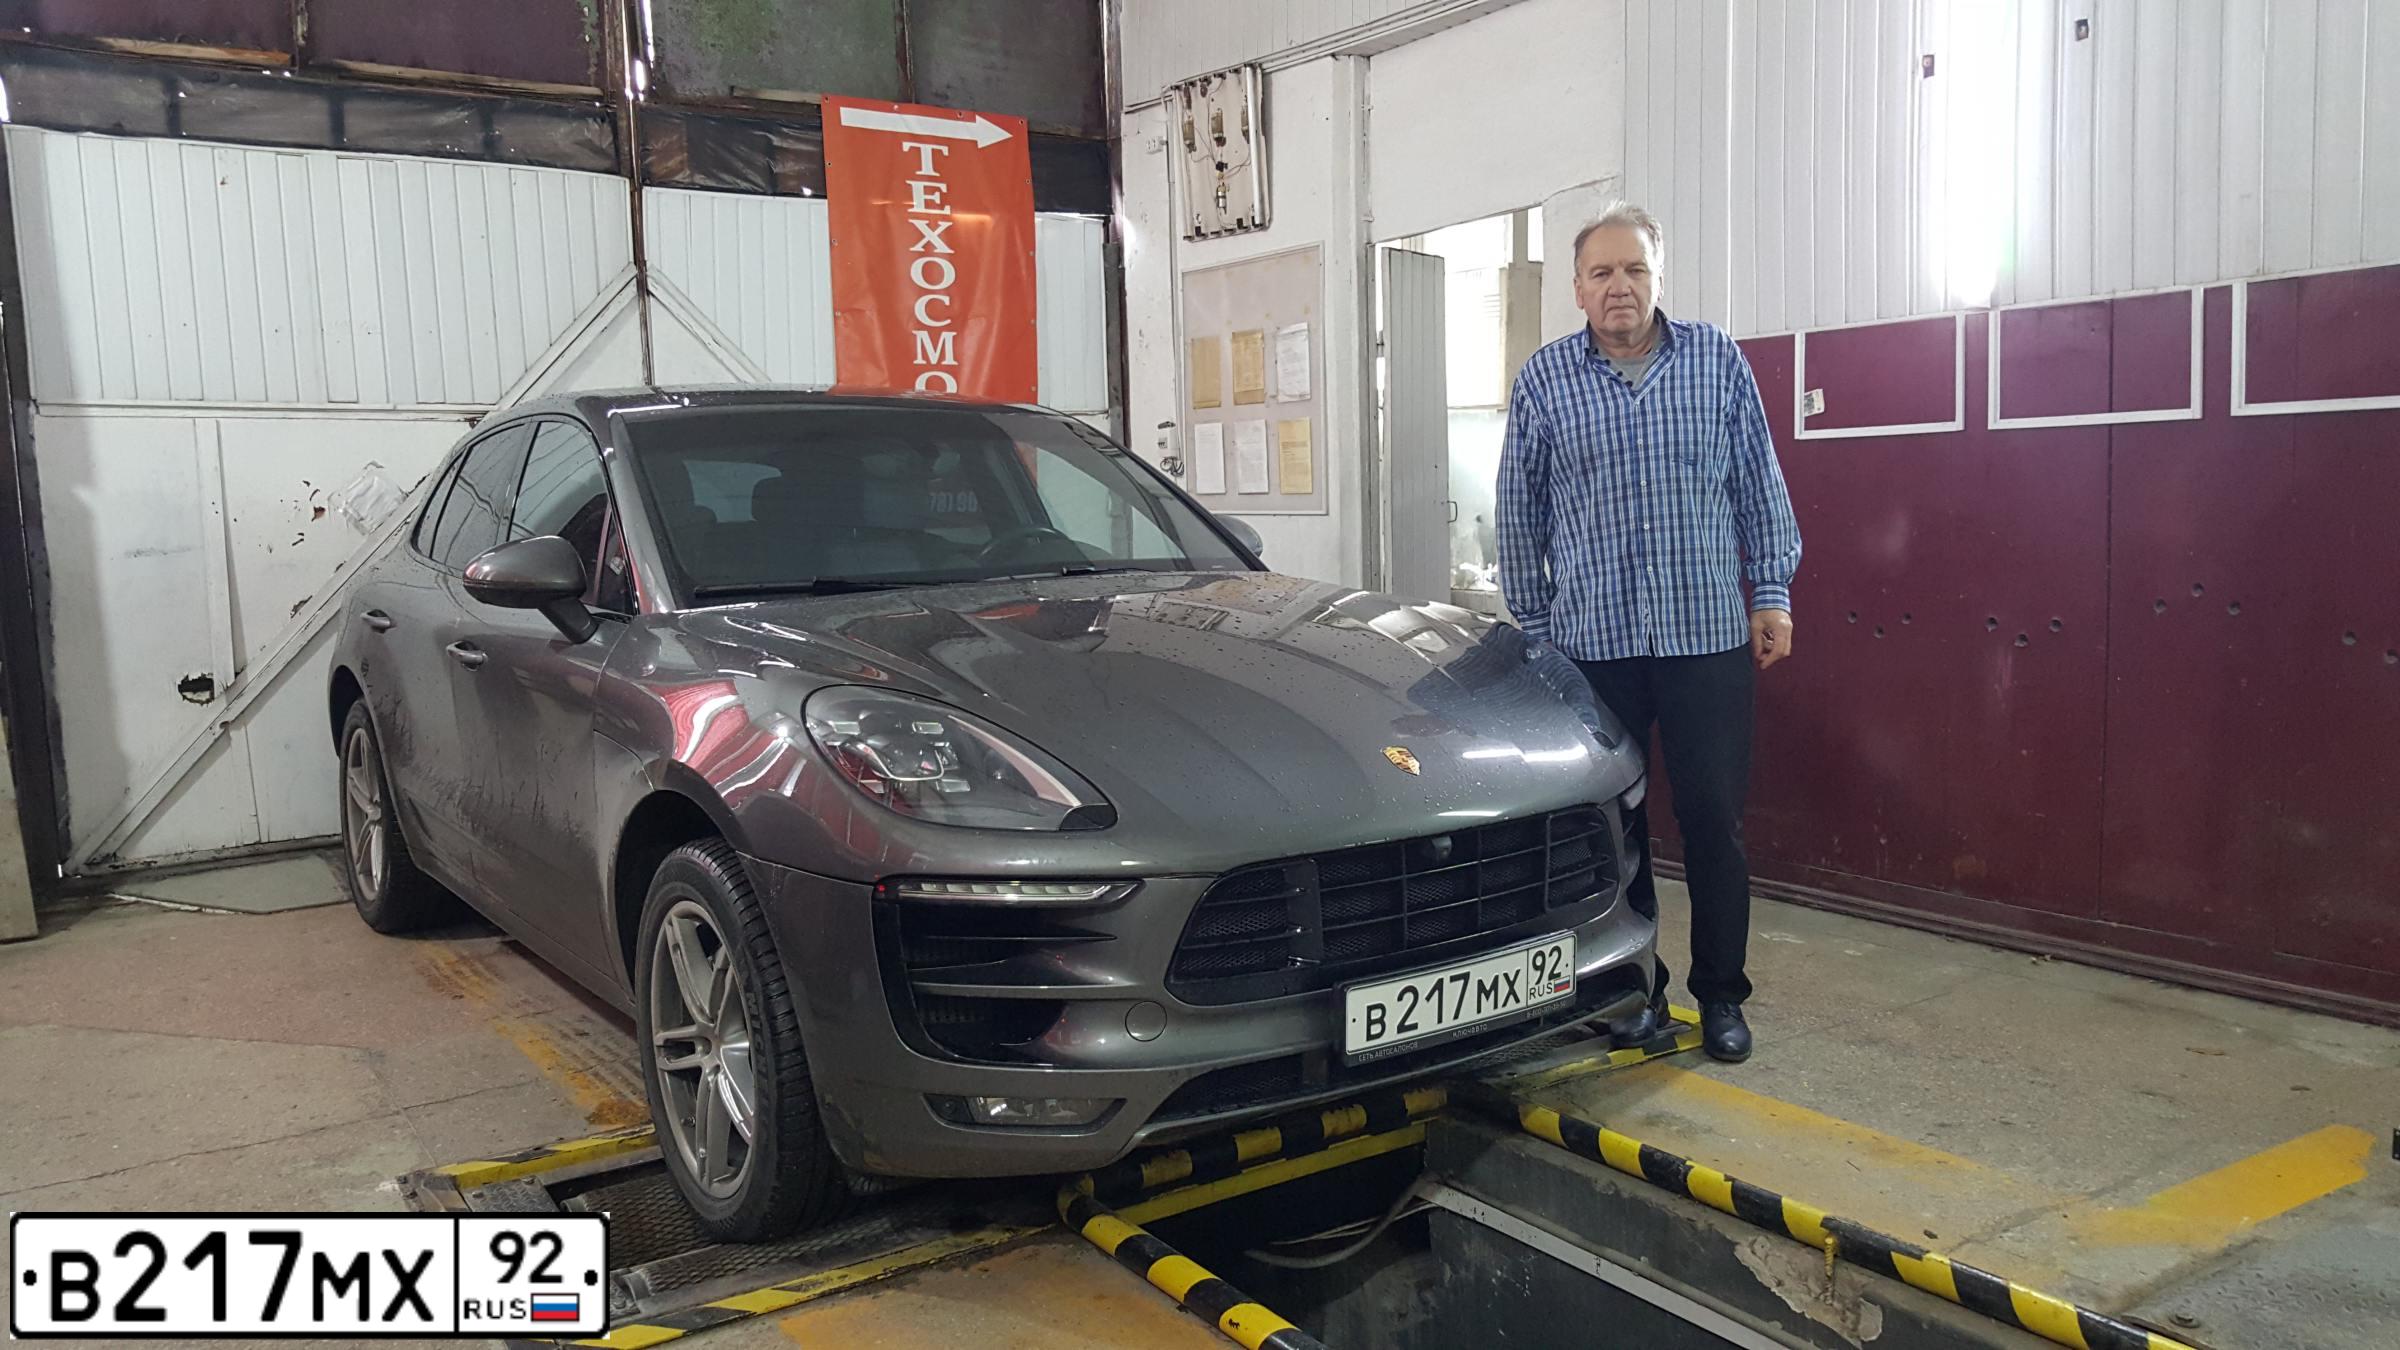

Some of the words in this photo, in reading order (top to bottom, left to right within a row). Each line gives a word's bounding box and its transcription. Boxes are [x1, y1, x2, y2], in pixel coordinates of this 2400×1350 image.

[1366, 968, 1521, 1042] В217МХ
[1532, 945, 1562, 986] 92
[1529, 982, 1553, 1000] RUS
[1358, 1054, 1374, 1062] СЕТЬ
